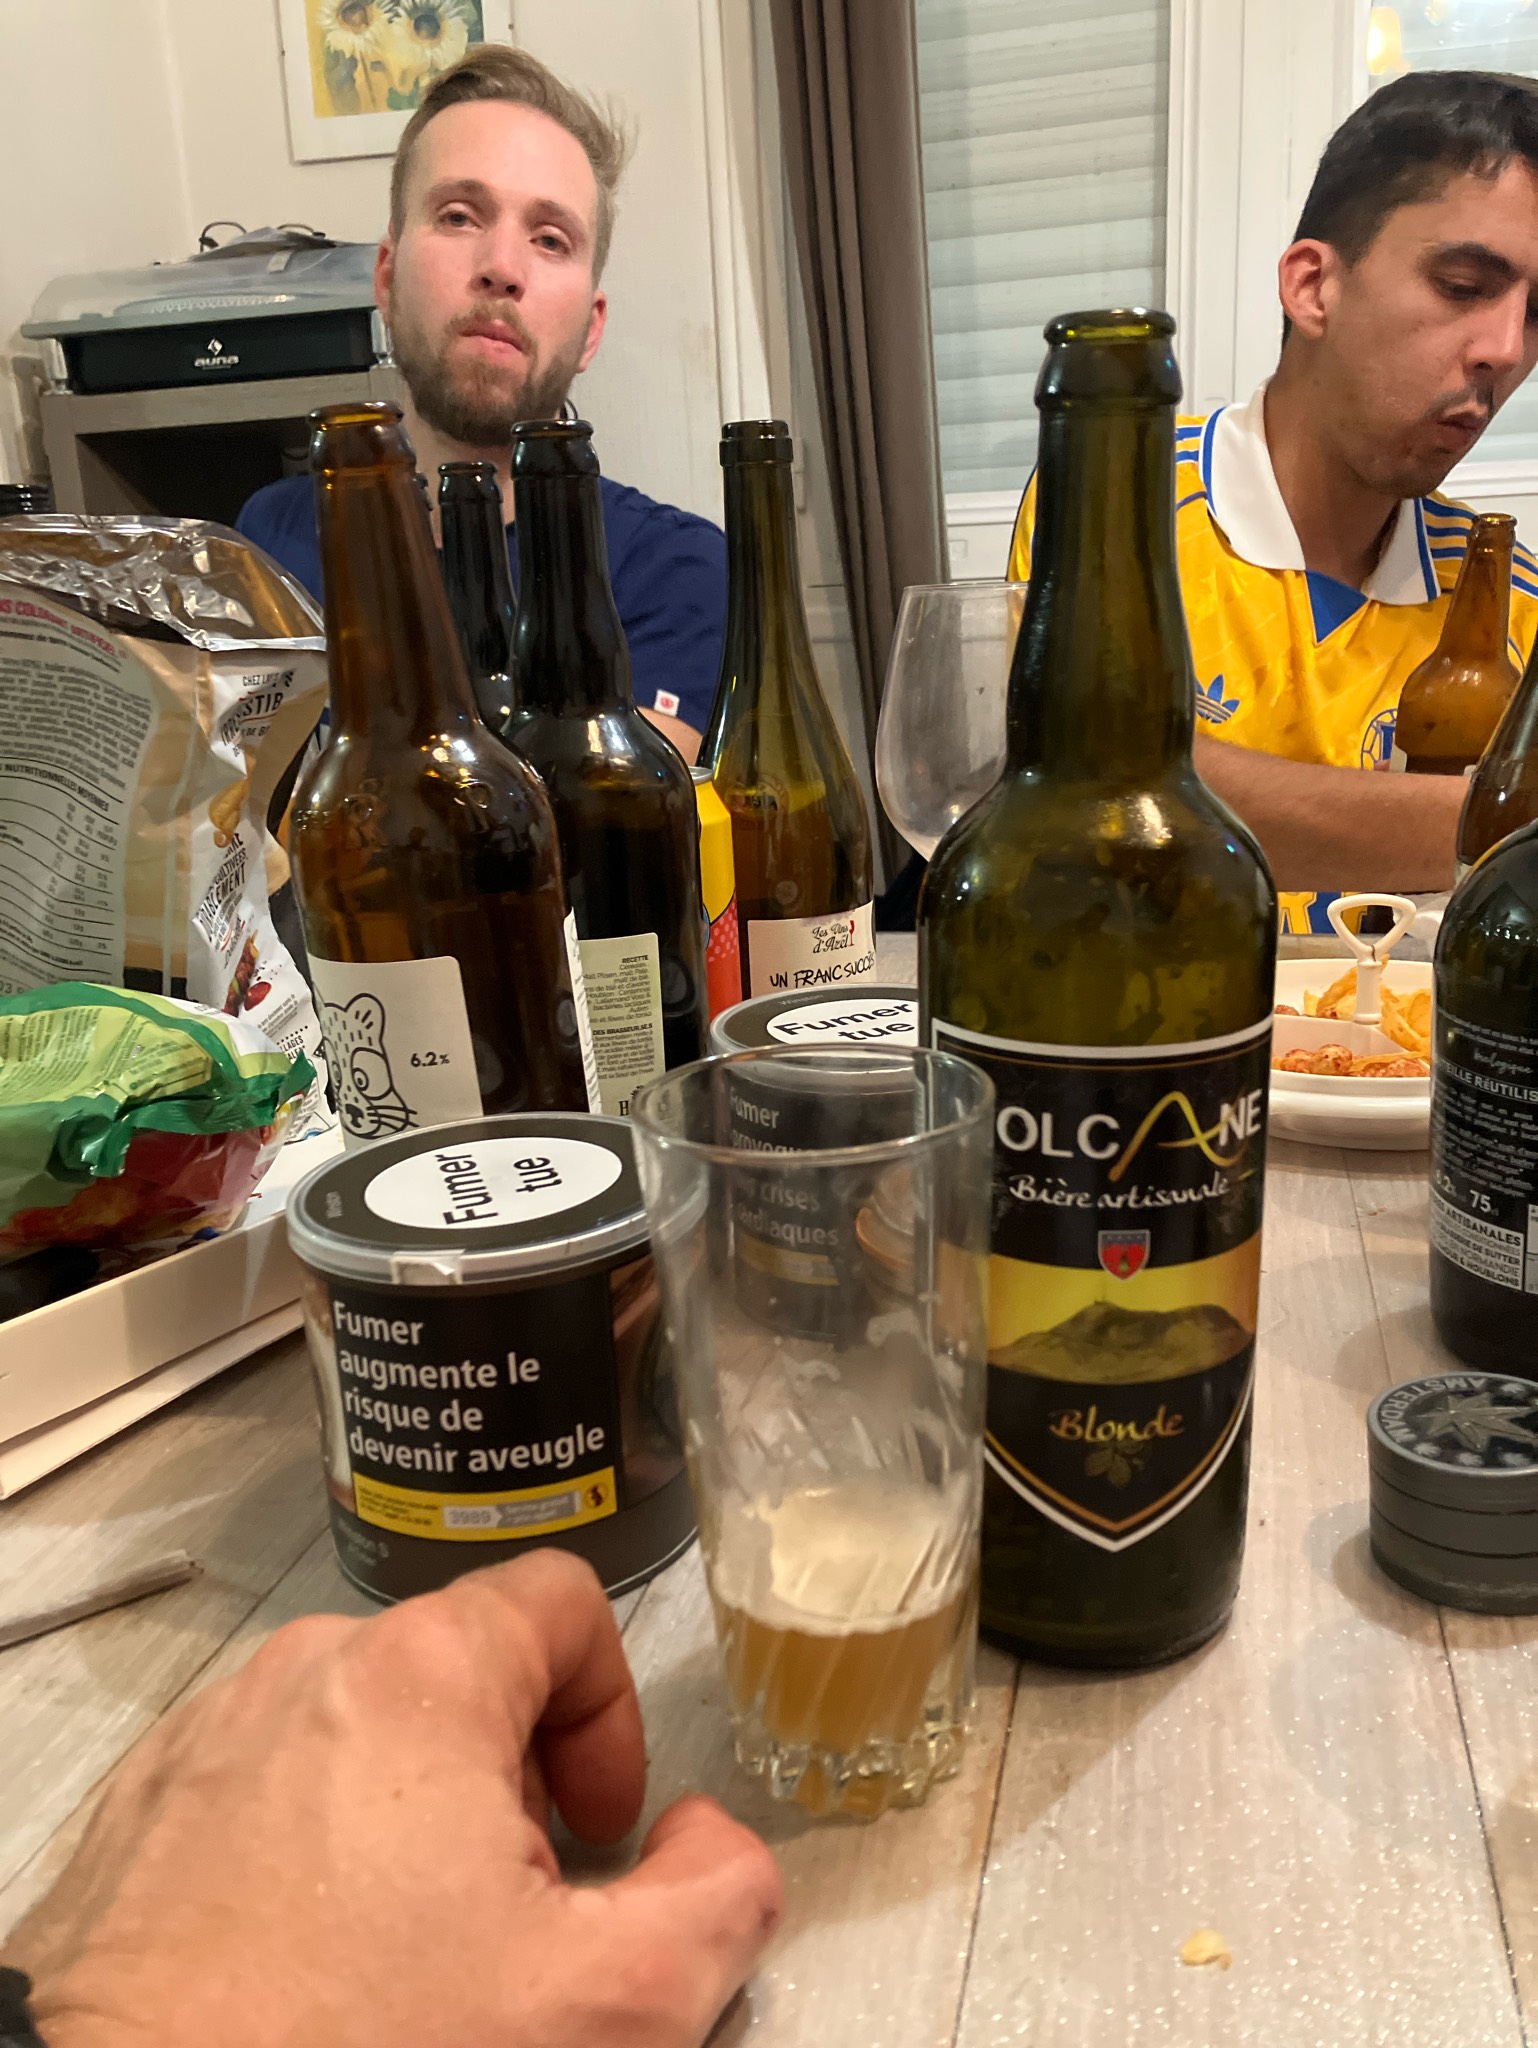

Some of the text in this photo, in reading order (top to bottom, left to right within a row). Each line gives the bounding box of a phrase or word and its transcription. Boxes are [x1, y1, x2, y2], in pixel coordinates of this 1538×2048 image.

[194, 355, 239, 367] auna
[812, 923, 849, 940] Les Vins
[622, 955, 648, 964] RECETTE
[770, 971, 788, 988] UN
[793, 965, 842, 989] FRANC
[773, 1004, 912, 1036] Fumer
[838, 1023, 915, 1040] tue
[411, 1051, 450, 1067] 6.2%
[997, 1089, 1262, 1182] OLCANE
[435, 1154, 498, 1225] Fumer
[513, 1157, 562, 1192] tue
[1009, 1170, 1230, 1209] Bière artisanale
[1470, 1189, 1492, 1213] 75
[1446, 1208, 1521, 1246] ARTISANALES
[333, 1300, 423, 1346] Fumer
[340, 1350, 541, 1391] augmente le
[344, 1387, 483, 1433] risque de
[1049, 1405, 1185, 1442] Blonde
[350, 1423, 605, 1473] devenir aveugle
